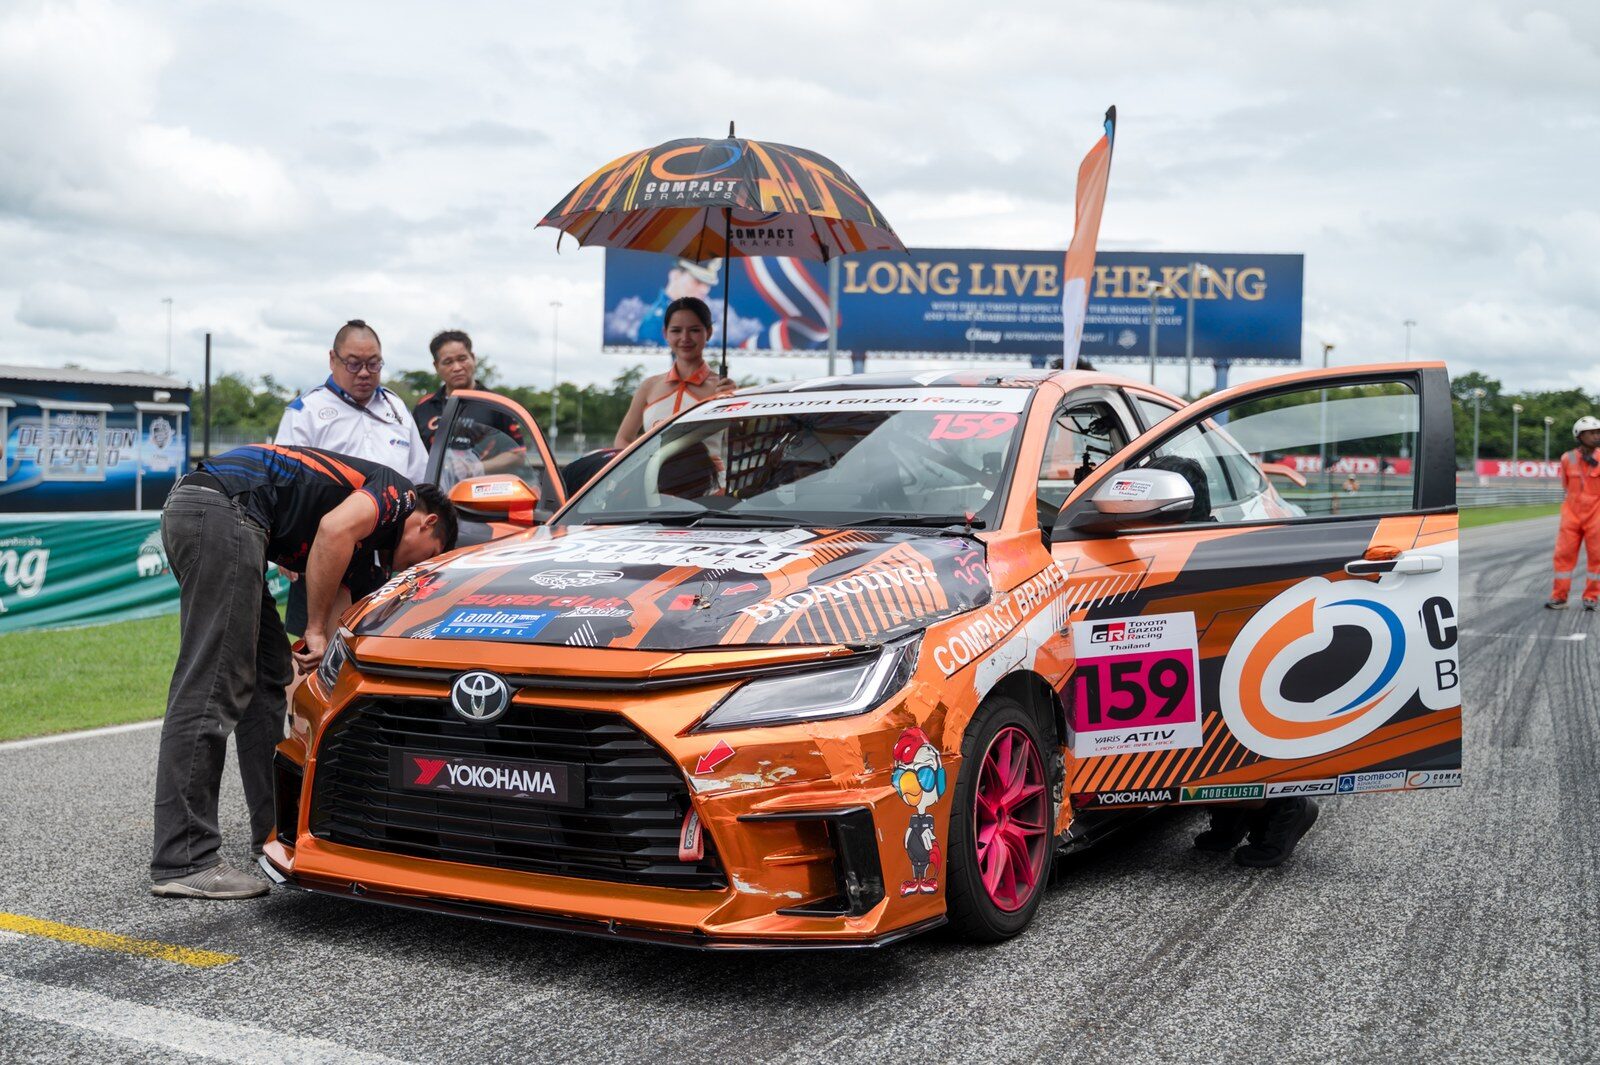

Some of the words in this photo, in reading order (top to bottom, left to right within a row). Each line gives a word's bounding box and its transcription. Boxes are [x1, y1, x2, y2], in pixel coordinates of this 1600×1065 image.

[645, 180, 737, 193] COMPACT
[644, 192, 733, 201] BRAKES
[843, 260, 962, 296] LONG
[968, 262, 1061, 297] LIVE
[1091, 265, 1152, 299] HE
[1159, 265, 1267, 301] KING
[752, 400, 832, 410] TOYOTA
[837, 397, 919, 405] GAZOO
[923, 397, 1004, 407] Racing
[928, 412, 1019, 441] 159
[18, 427, 137, 449] DESTINAION
[588, 545, 799, 561] COMPACT
[568, 553, 772, 570] BRAKES
[453, 611, 521, 624] Lamina
[933, 597, 1023, 677] COMPACT
[1013, 560, 1070, 617] BRAKES
[441, 627, 526, 636] DIGITAL
[1091, 628, 1126, 643] GR
[1129, 620, 1167, 628] TOYOTA
[1127, 632, 1163, 641] Racing
[1128, 626, 1164, 634] GAZOO
[1109, 642, 1151, 651] Thailand
[1072, 657, 1189, 724] 159
[1094, 735, 1121, 744] YARIS
[1122, 729, 1176, 743] ATIV
[446, 763, 557, 794] YOKOHAMA
[1357, 771, 1405, 782] SOMBOON
[1201, 786, 1260, 799] MODELLISTA
[1268, 782, 1333, 794] LENSO
[1097, 789, 1172, 804] YOKOHAMA
